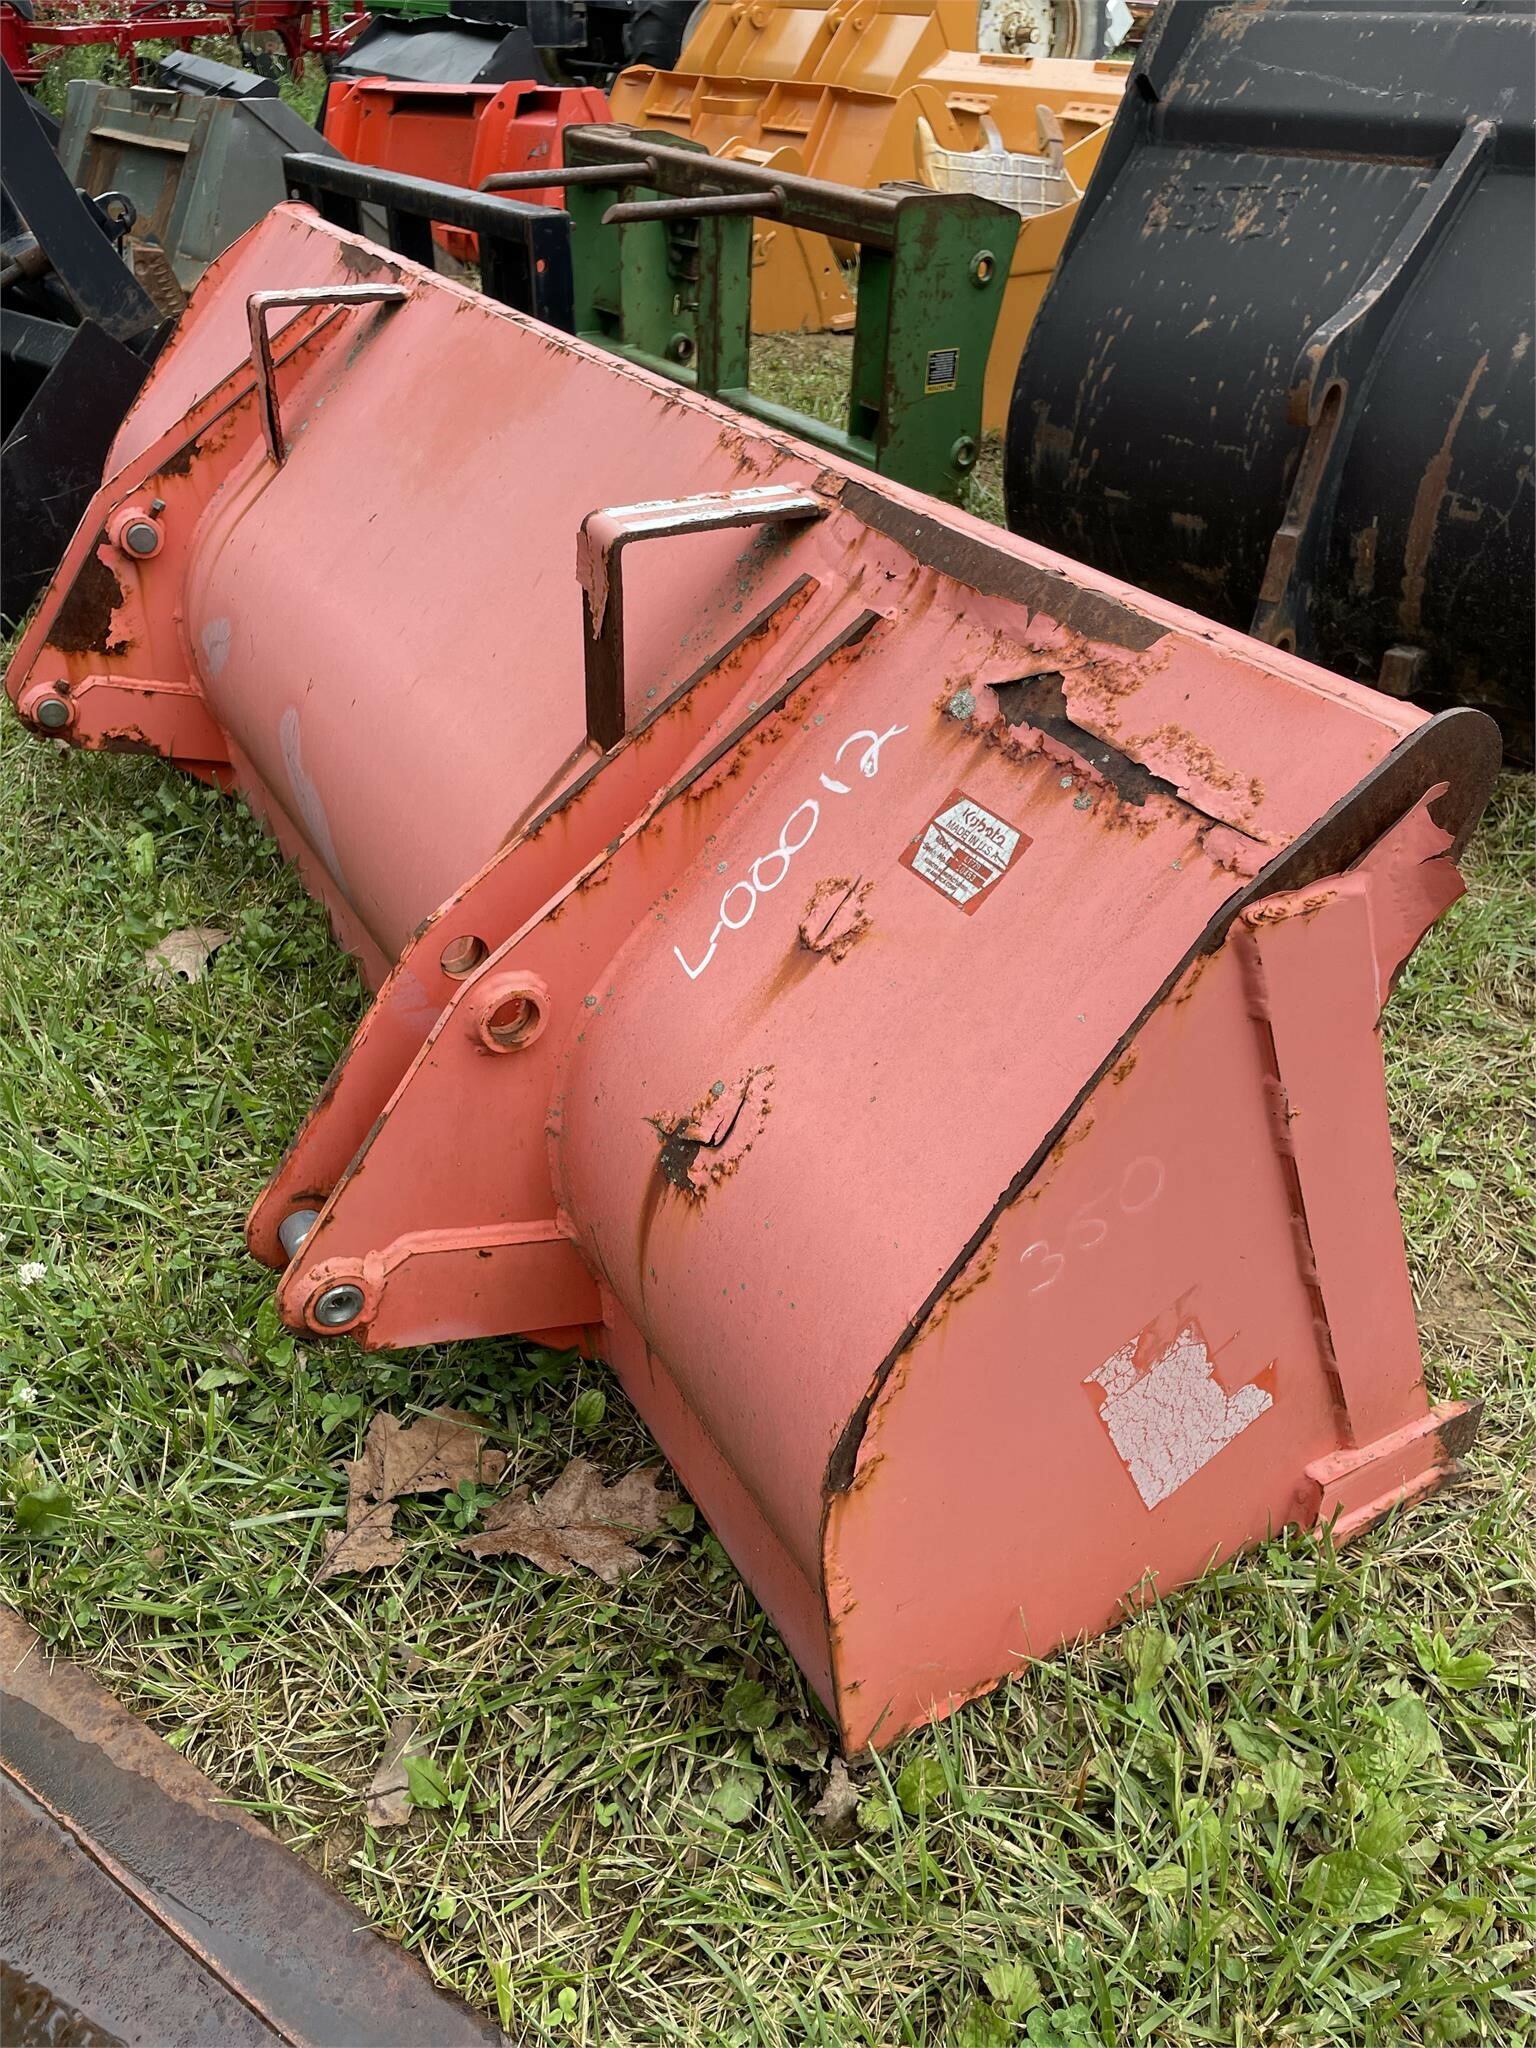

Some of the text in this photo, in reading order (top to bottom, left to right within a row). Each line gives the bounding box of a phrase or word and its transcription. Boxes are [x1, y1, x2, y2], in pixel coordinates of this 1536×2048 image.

[945, 819, 971, 841] MADE
[968, 835, 980, 846] IN
[963, 807, 1006, 849] Kubota
[1019, 1155, 1166, 1297] 350
